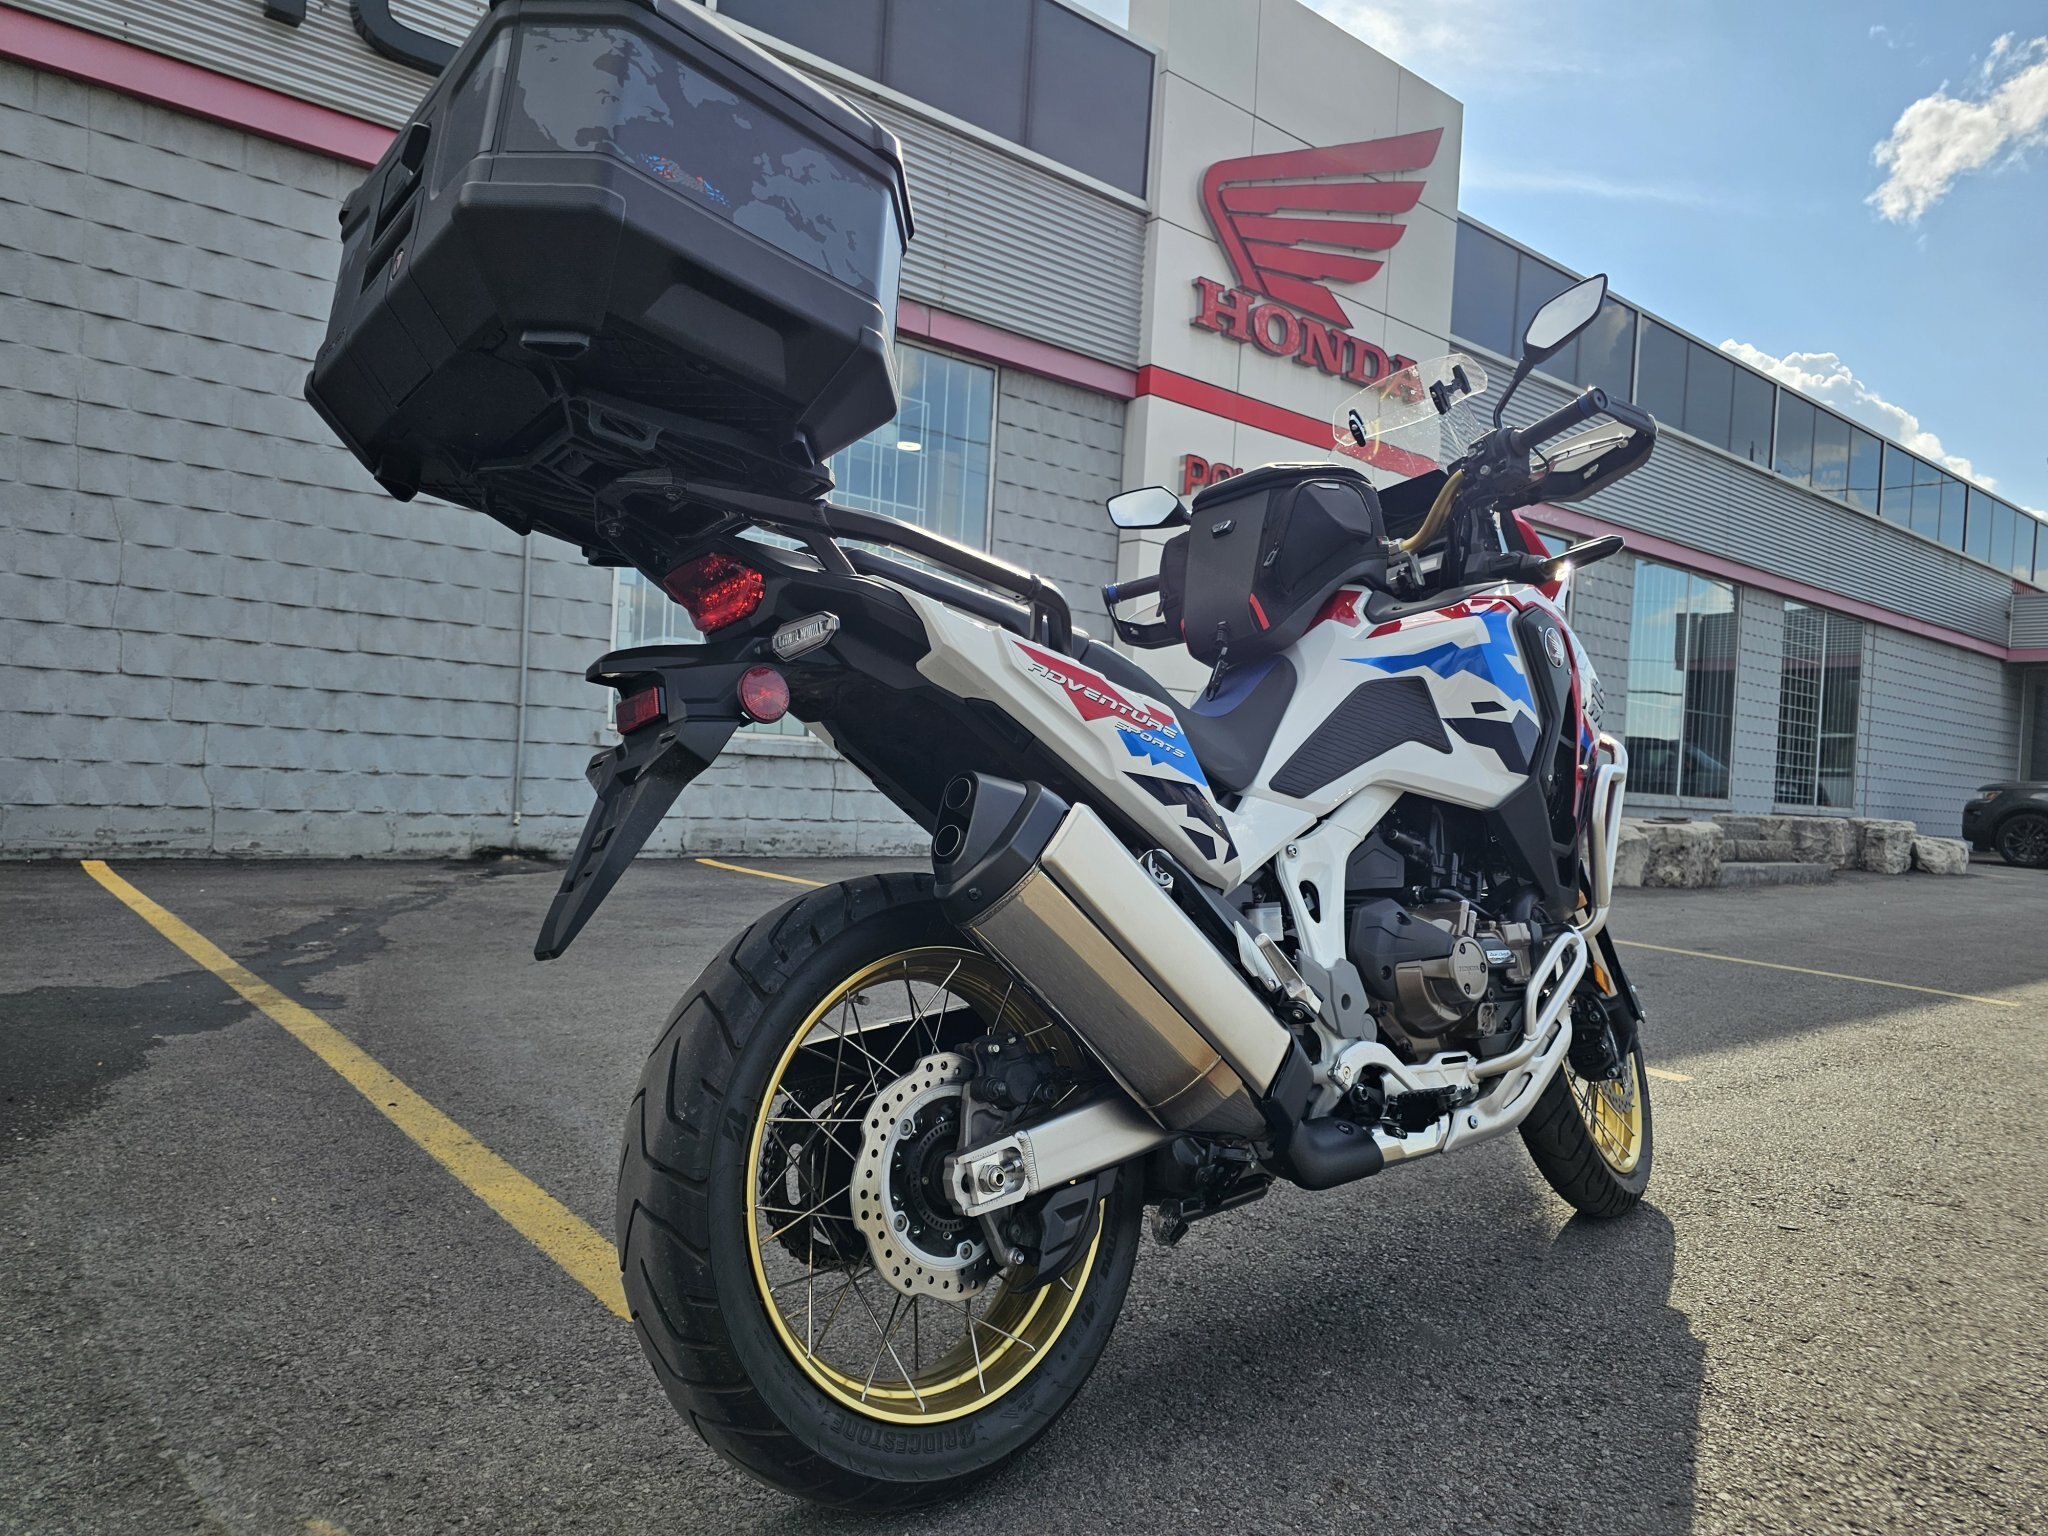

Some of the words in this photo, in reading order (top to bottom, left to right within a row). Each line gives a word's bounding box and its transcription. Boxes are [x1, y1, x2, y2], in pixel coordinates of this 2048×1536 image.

[1190, 276, 1424, 404] HONDA
[1028, 663, 1178, 739] ADVENTURE
[1114, 721, 1187, 758] SPORTS
[830, 1411, 976, 1454] BRIDGESTONE
